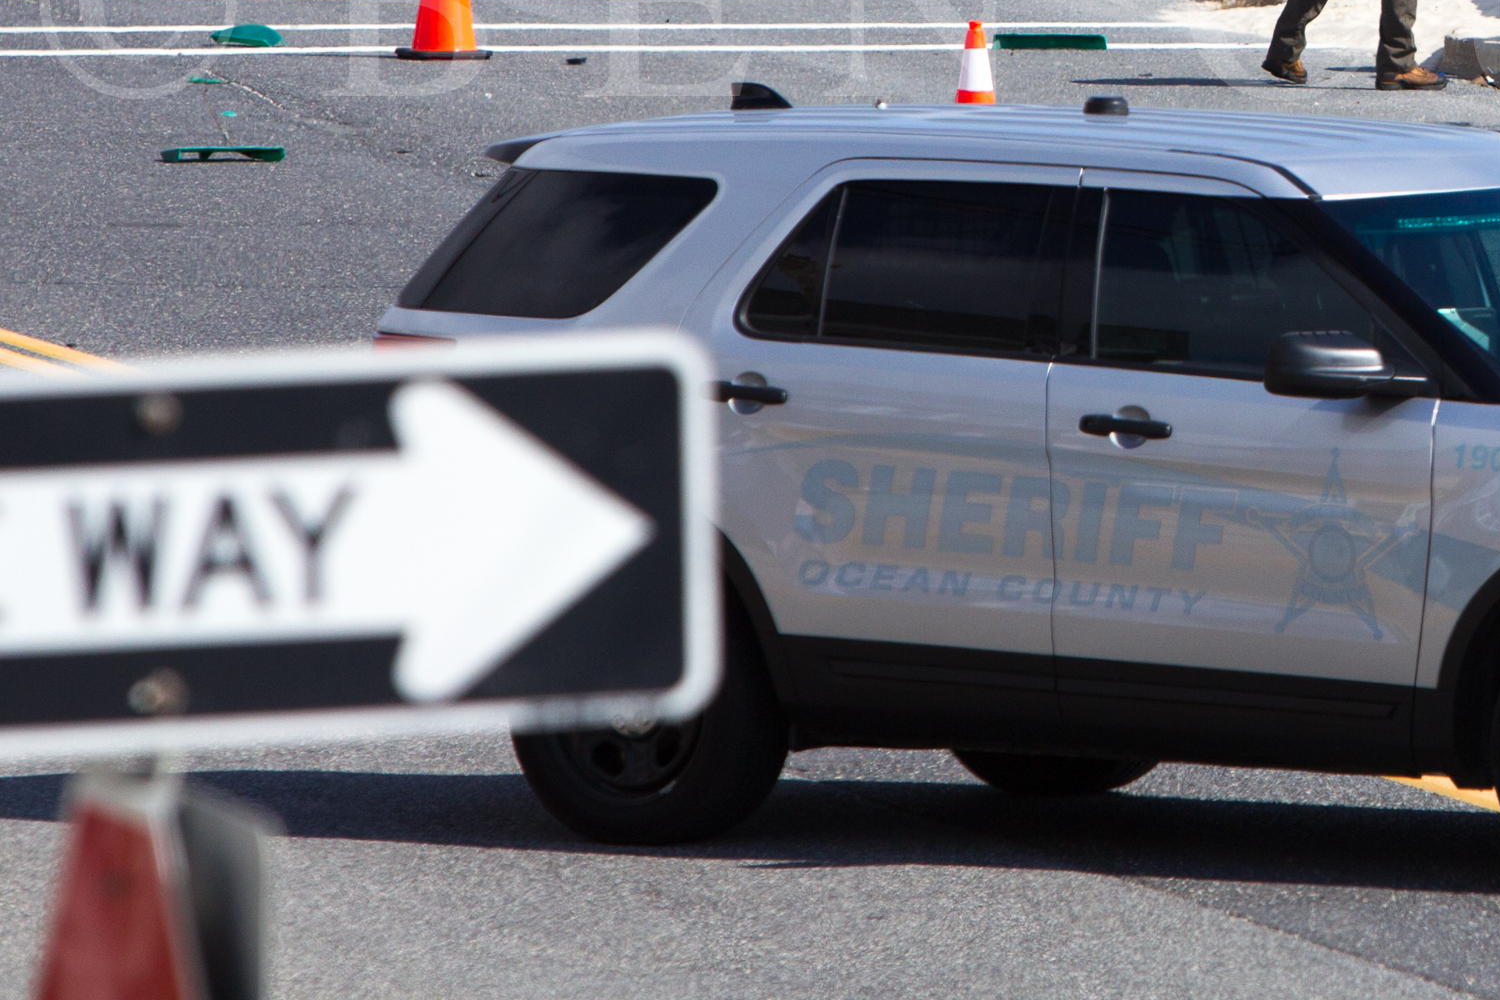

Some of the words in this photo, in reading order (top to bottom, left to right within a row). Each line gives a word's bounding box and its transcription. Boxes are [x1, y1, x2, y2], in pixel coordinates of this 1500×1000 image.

[62, 481, 358, 612] WAY
[794, 459, 1238, 571] SHERIFF
[800, 559, 972, 597] OCEAN
[999, 575, 1208, 616] COUNTY
